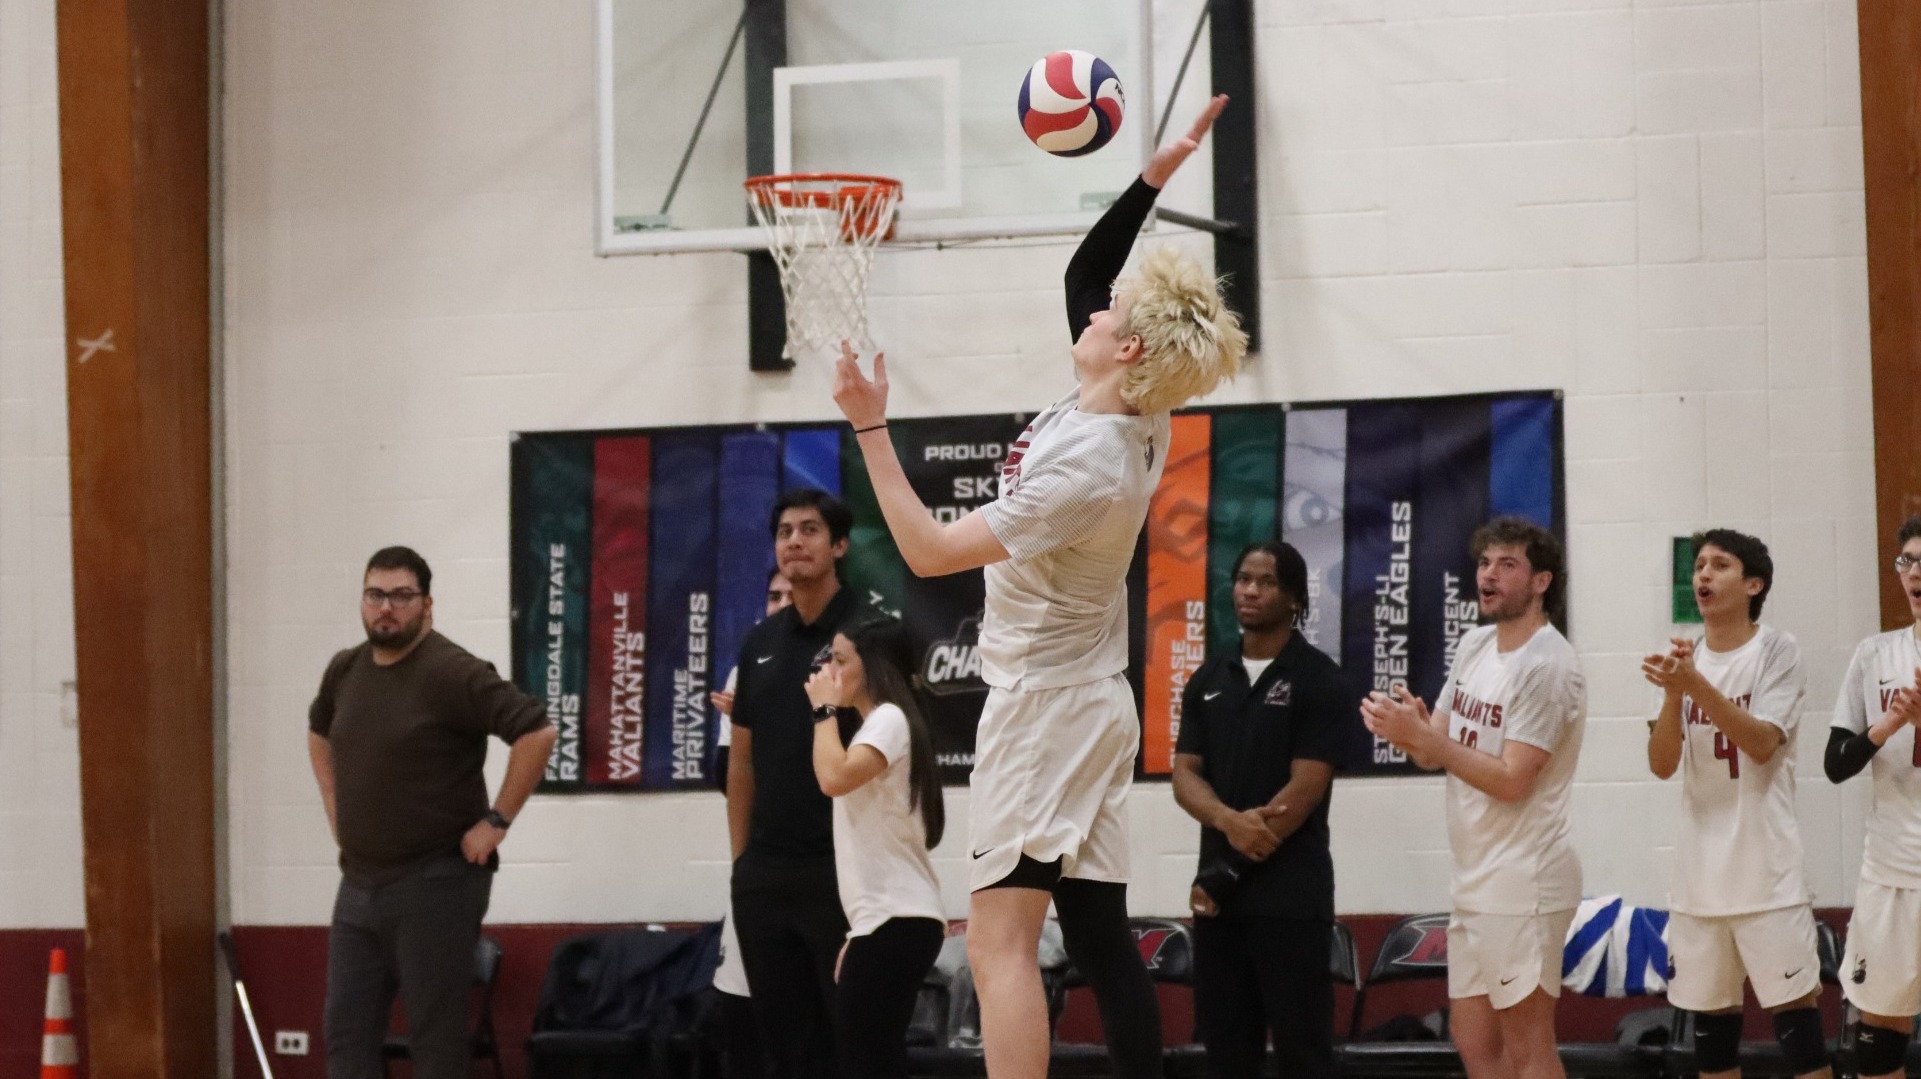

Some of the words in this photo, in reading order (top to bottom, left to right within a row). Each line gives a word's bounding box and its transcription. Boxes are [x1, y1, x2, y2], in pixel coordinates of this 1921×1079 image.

[924, 443, 1003, 462] PROUD
[953, 477, 1000, 499] SK
[548, 543, 566, 615] STATE
[1390, 502, 1411, 624] EAGLES
[545, 621, 563, 781] FAINGDALE
[621, 632, 646, 779] VALIANTS
[685, 593, 709, 779] PRIVATEERS
[927, 645, 982, 683] CHA
[560, 694, 579, 781] RAMS
[672, 668, 688, 780] MARITIME
[1715, 732, 1739, 779] 4
